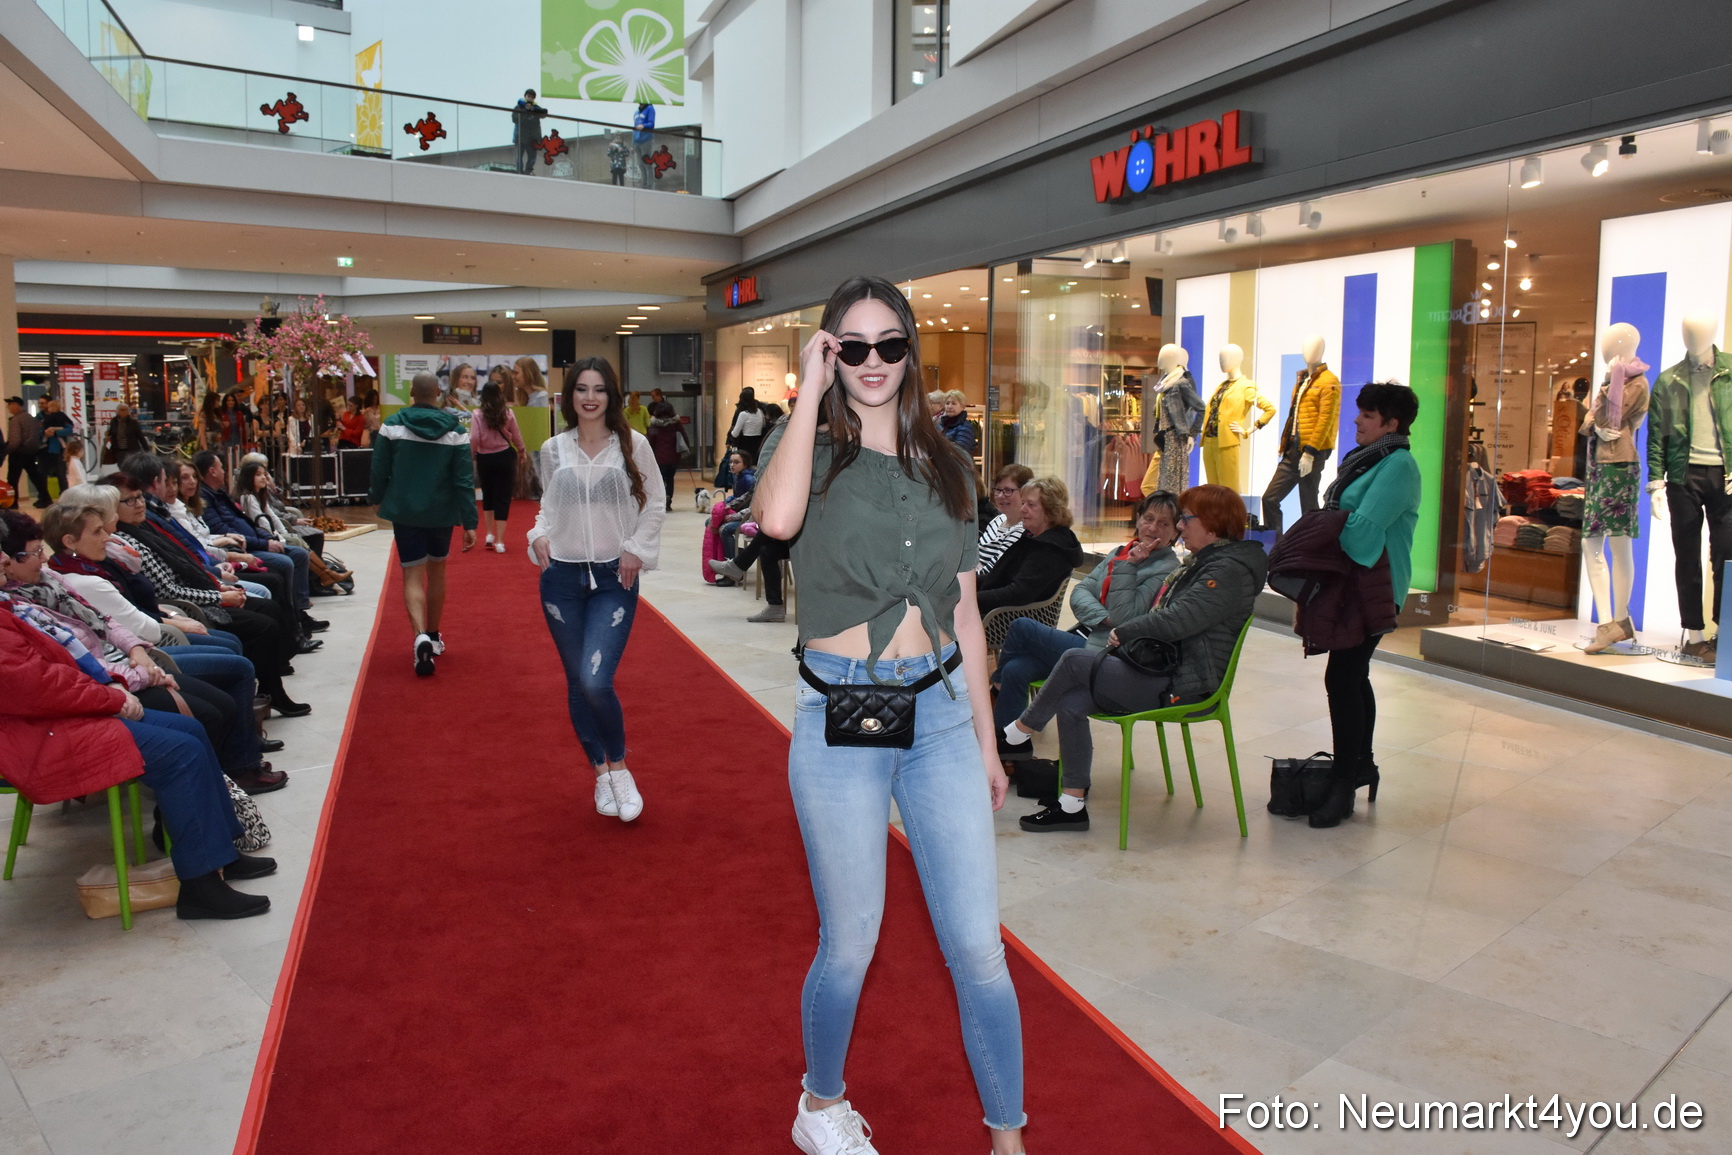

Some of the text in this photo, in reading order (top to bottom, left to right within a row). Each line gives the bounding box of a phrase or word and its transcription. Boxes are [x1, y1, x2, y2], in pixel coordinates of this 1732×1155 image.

[1090, 109, 1252, 203] WÖHRL
[723, 275, 758, 308] WÖHRL
[105, 388, 117, 397] dm
[1509, 616, 1557, 635] AMBER & JUNE
[1639, 645, 1704, 663] GERRY WEBER
